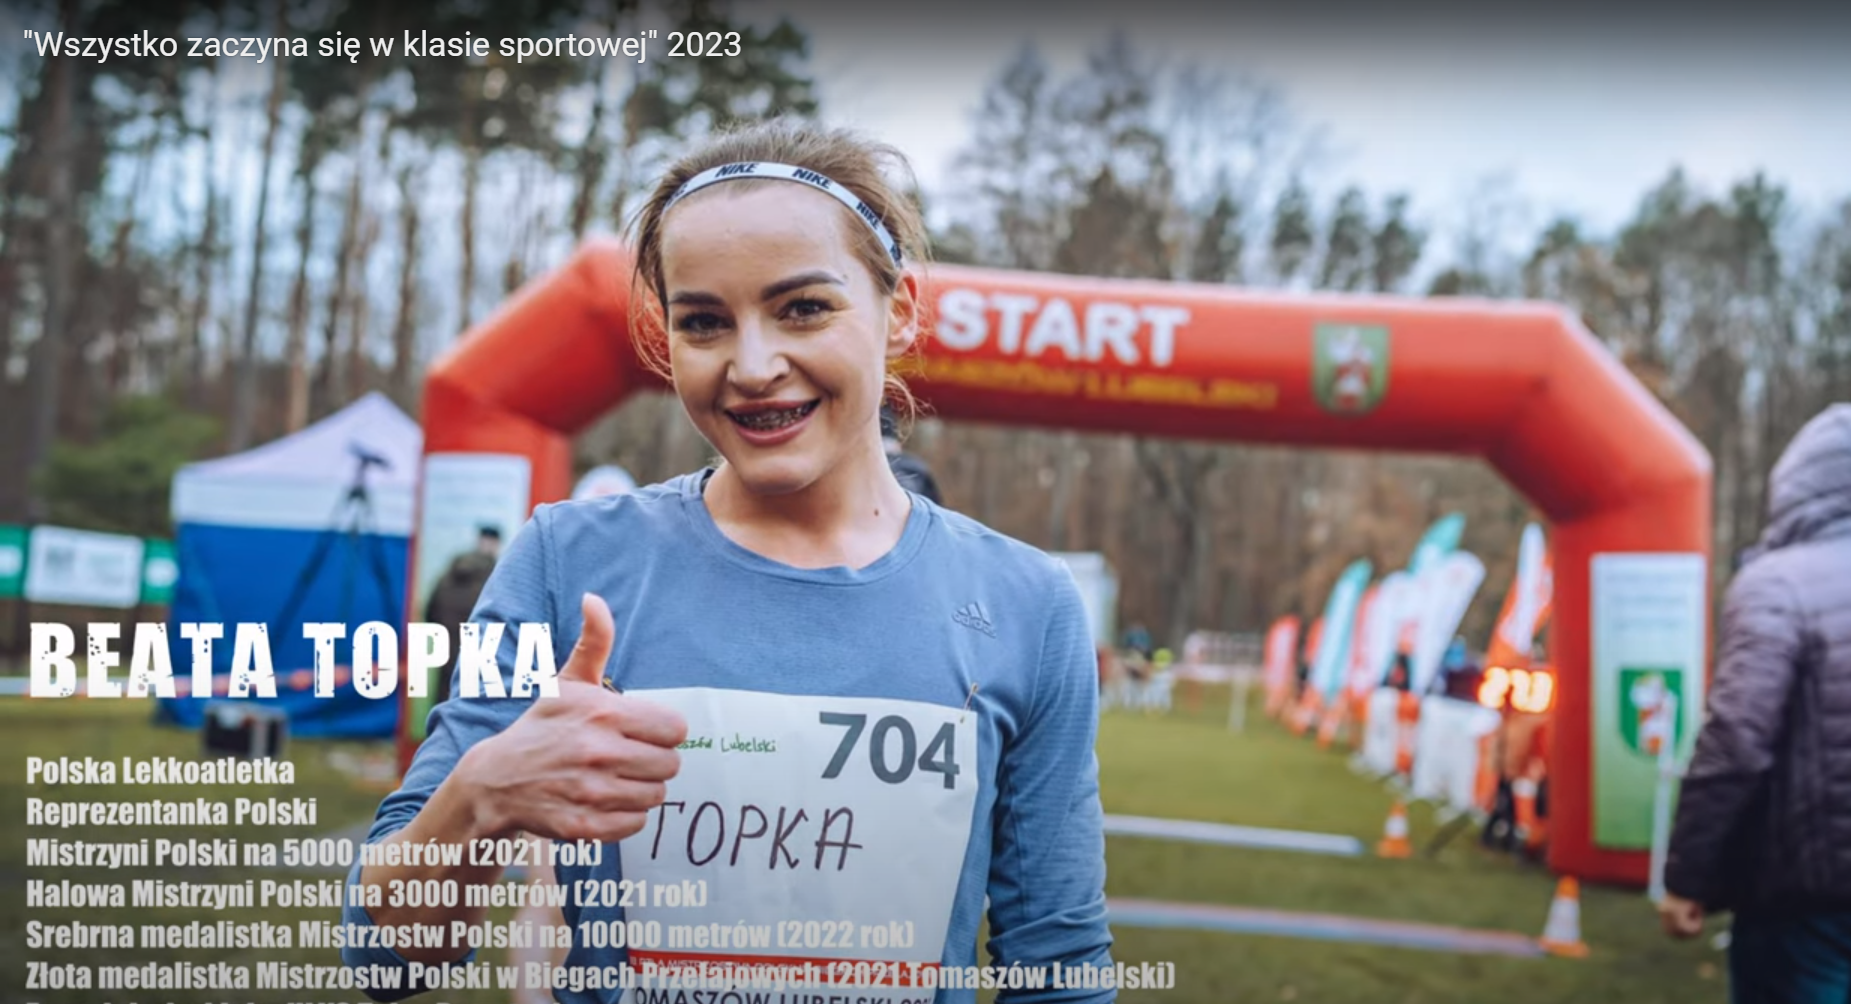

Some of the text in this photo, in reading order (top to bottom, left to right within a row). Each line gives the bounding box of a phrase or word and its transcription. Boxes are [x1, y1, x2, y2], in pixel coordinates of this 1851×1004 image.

[715, 162, 760, 178] NIKE
[791, 167, 833, 190] NIKE
[855, 201, 881, 231] NIKE
[936, 287, 1191, 367] START
[819, 711, 960, 790] 704
[646, 800, 863, 871] TOPKA
